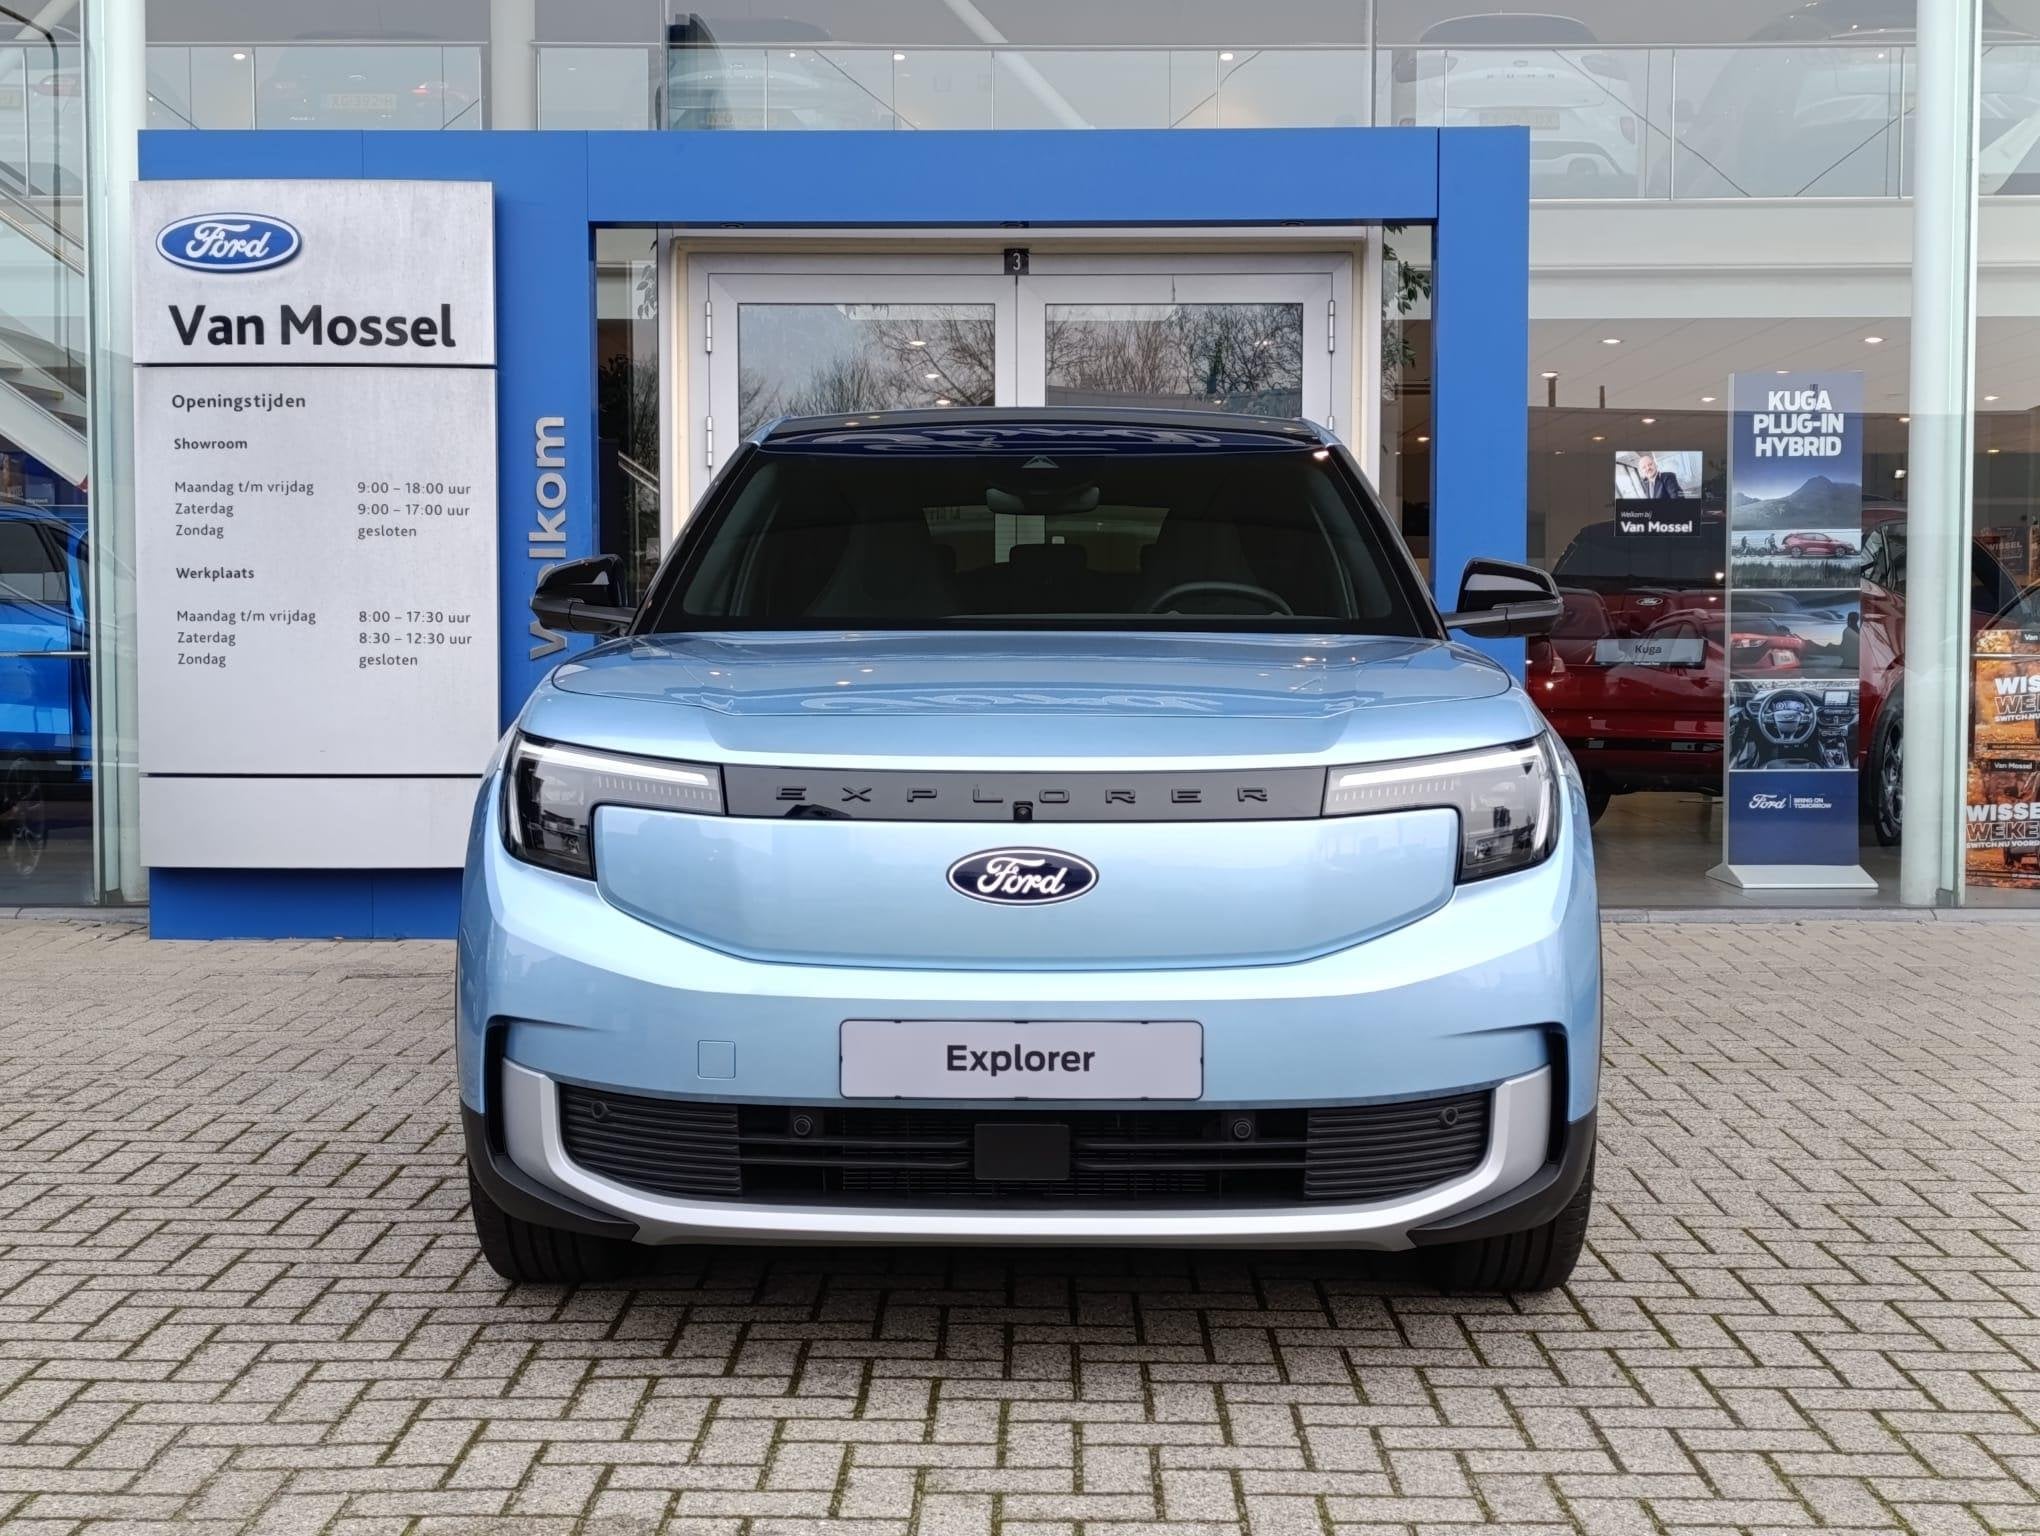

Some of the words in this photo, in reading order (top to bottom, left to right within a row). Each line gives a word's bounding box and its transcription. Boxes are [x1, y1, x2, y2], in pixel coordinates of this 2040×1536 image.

[1012, 252, 1021, 271] 3
[168, 304, 265, 346] Van
[281, 304, 457, 347] Mossel
[172, 393, 306, 414] Openingstijden
[1768, 390, 1832, 411] KUGA
[1753, 413, 1844, 434] PLUG-IN
[174, 438, 248, 450] Showroom
[1755, 436, 1842, 457] HYBRID
[175, 481, 234, 496] Maandag
[238, 481, 263, 493] t/m
[267, 480, 314, 496] vrijdag
[357, 482, 389, 494] 9:00
[405, 482, 443, 494] 18:00
[449, 485, 471, 495] uur
[175, 502, 234, 518] Zaterdag
[357, 503, 389, 515] 9:00
[405, 503, 442, 516] 17:00
[447, 506, 470, 516] uur
[175, 523, 224, 539] Zondag
[357, 525, 417, 540] gesloten
[1621, 521, 1645, 533] Van
[1648, 520, 1693, 533] Mossel
[528, 416, 567, 661] wlkom
[176, 567, 255, 582] Werkplaats
[176, 610, 236, 625] Maandag
[240, 610, 265, 622] t/m
[269, 610, 317, 625] vrijdag
[359, 611, 390, 623] 8:00
[406, 611, 444, 623] 17:30
[448, 613, 471, 624] uur
[177, 631, 236, 647] Zaterdag
[359, 632, 390, 644] 8:30
[406, 632, 445, 645] 12:30
[449, 635, 472, 645] uur
[2024, 633, 2039, 641] Van
[1635, 645, 1662, 656] Kuga
[178, 653, 227, 668] Zondag
[359, 653, 418, 669] gesloten
[1995, 675, 2040, 695] WIS
[1995, 694, 2040, 715] WE
[776, 784, 1269, 804] EXPLORER
[1748, 794, 1787, 809] Ford
[946, 1043, 1096, 1078] Explorer
